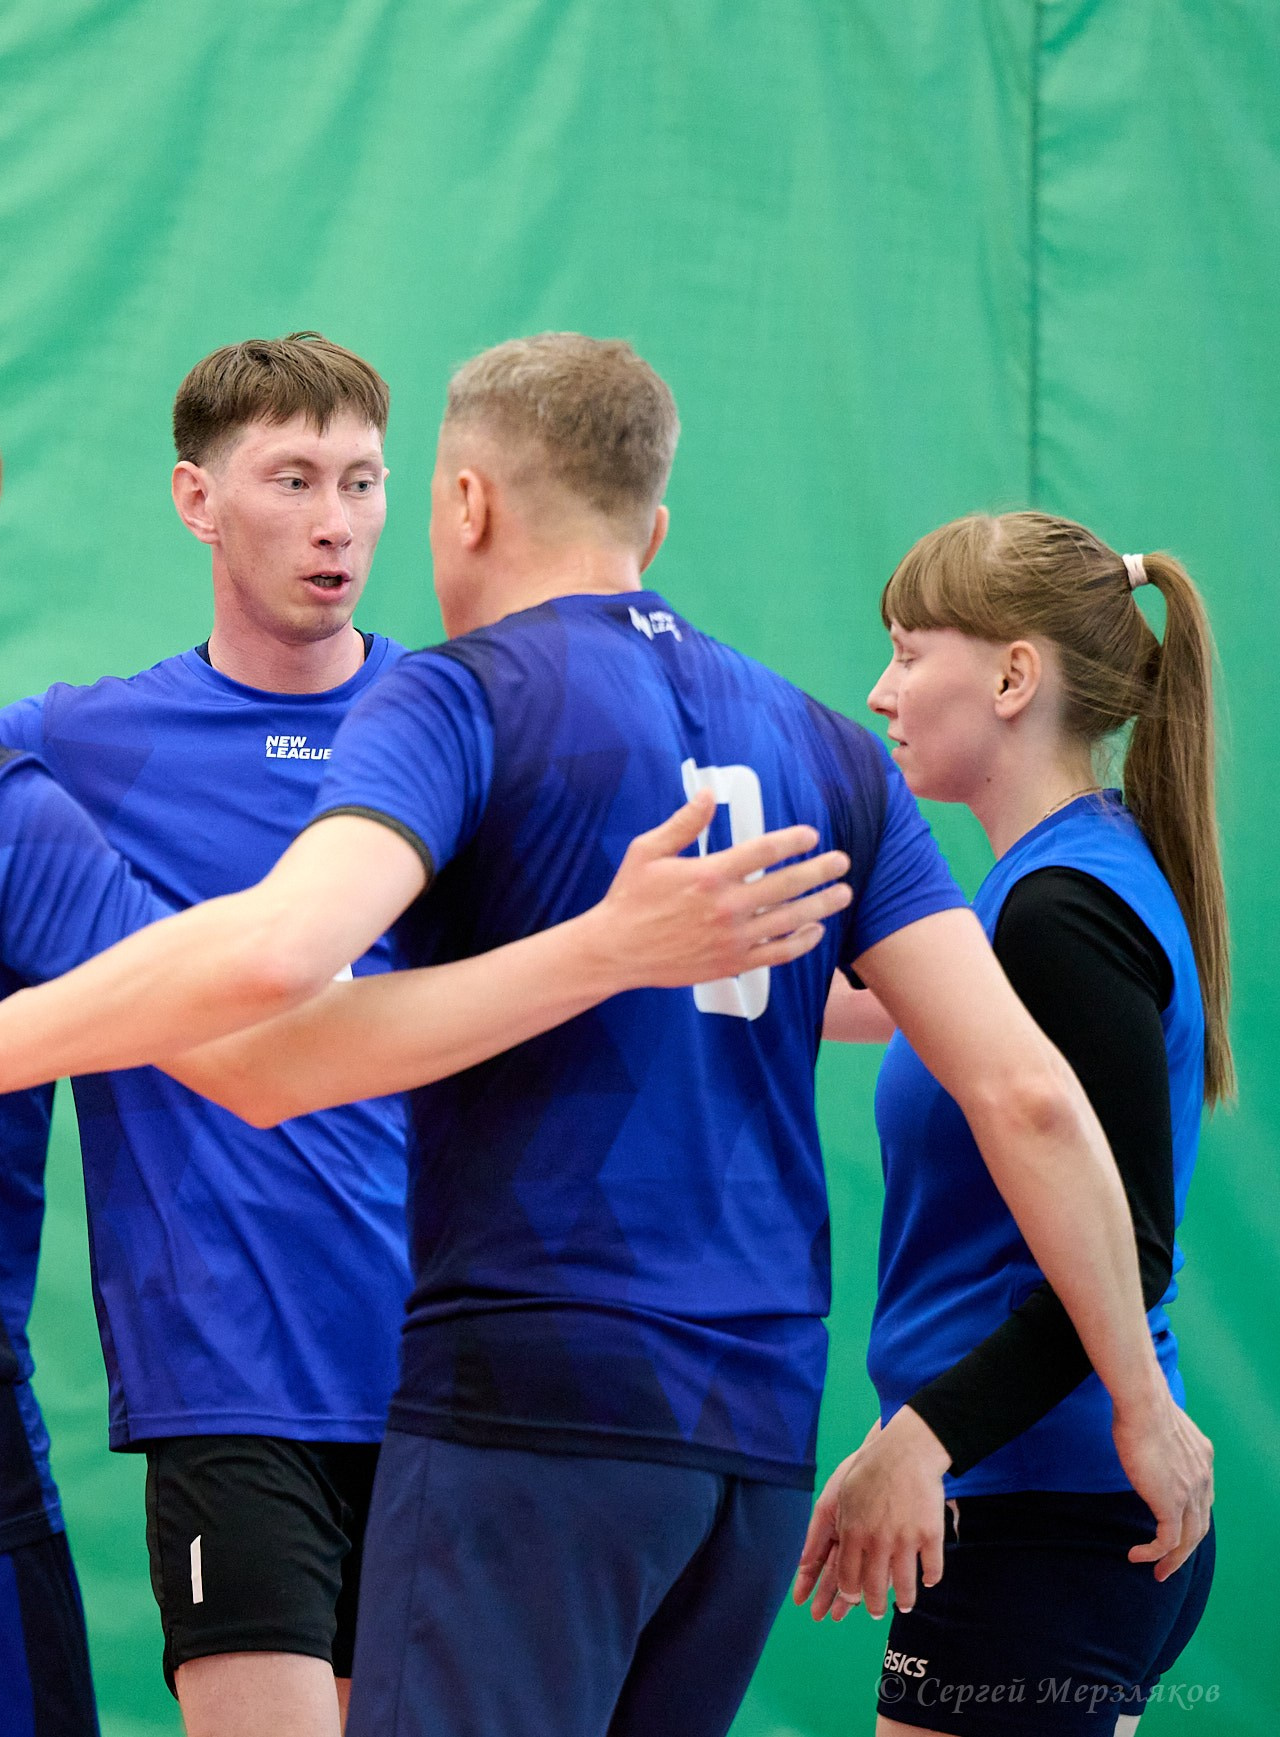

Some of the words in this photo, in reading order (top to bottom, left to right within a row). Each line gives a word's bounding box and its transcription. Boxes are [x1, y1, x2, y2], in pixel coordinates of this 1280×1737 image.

[265, 735, 307, 748] NEW
[265, 746, 333, 760] LEAGUE
[190, 1534, 204, 1605] 1
